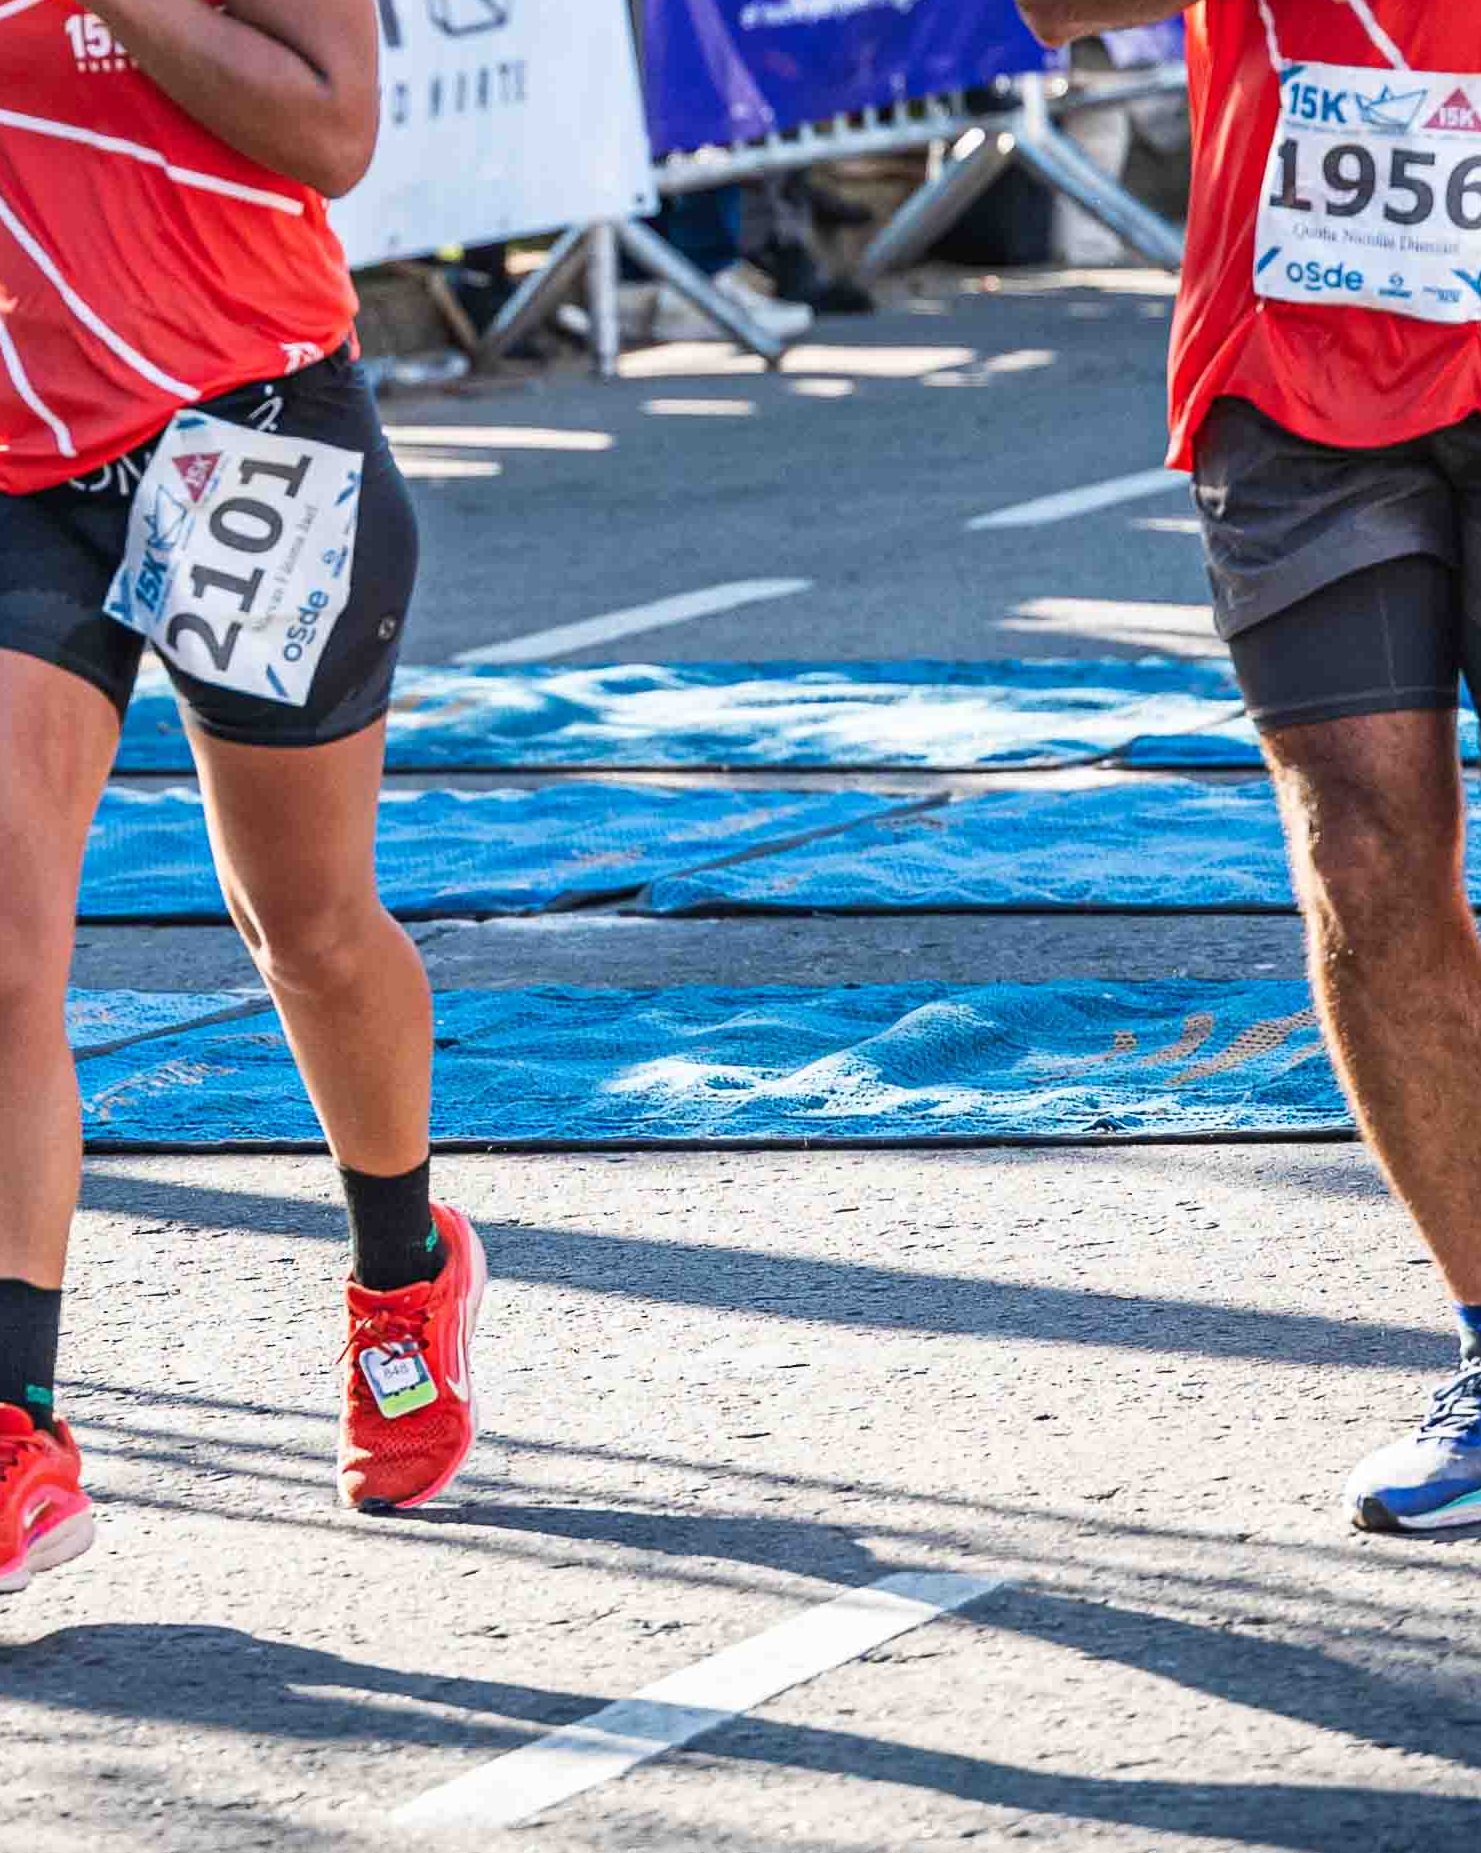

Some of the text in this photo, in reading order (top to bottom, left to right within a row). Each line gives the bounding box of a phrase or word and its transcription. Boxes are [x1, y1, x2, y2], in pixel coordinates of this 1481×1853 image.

[64, 13, 125, 60] 15
[1288, 82, 1349, 124] 15K
[1286, 261, 1365, 291] osde
[135, 549, 168, 612] 15K
[165, 454, 314, 672] 2101
[282, 589, 330, 662] osde
